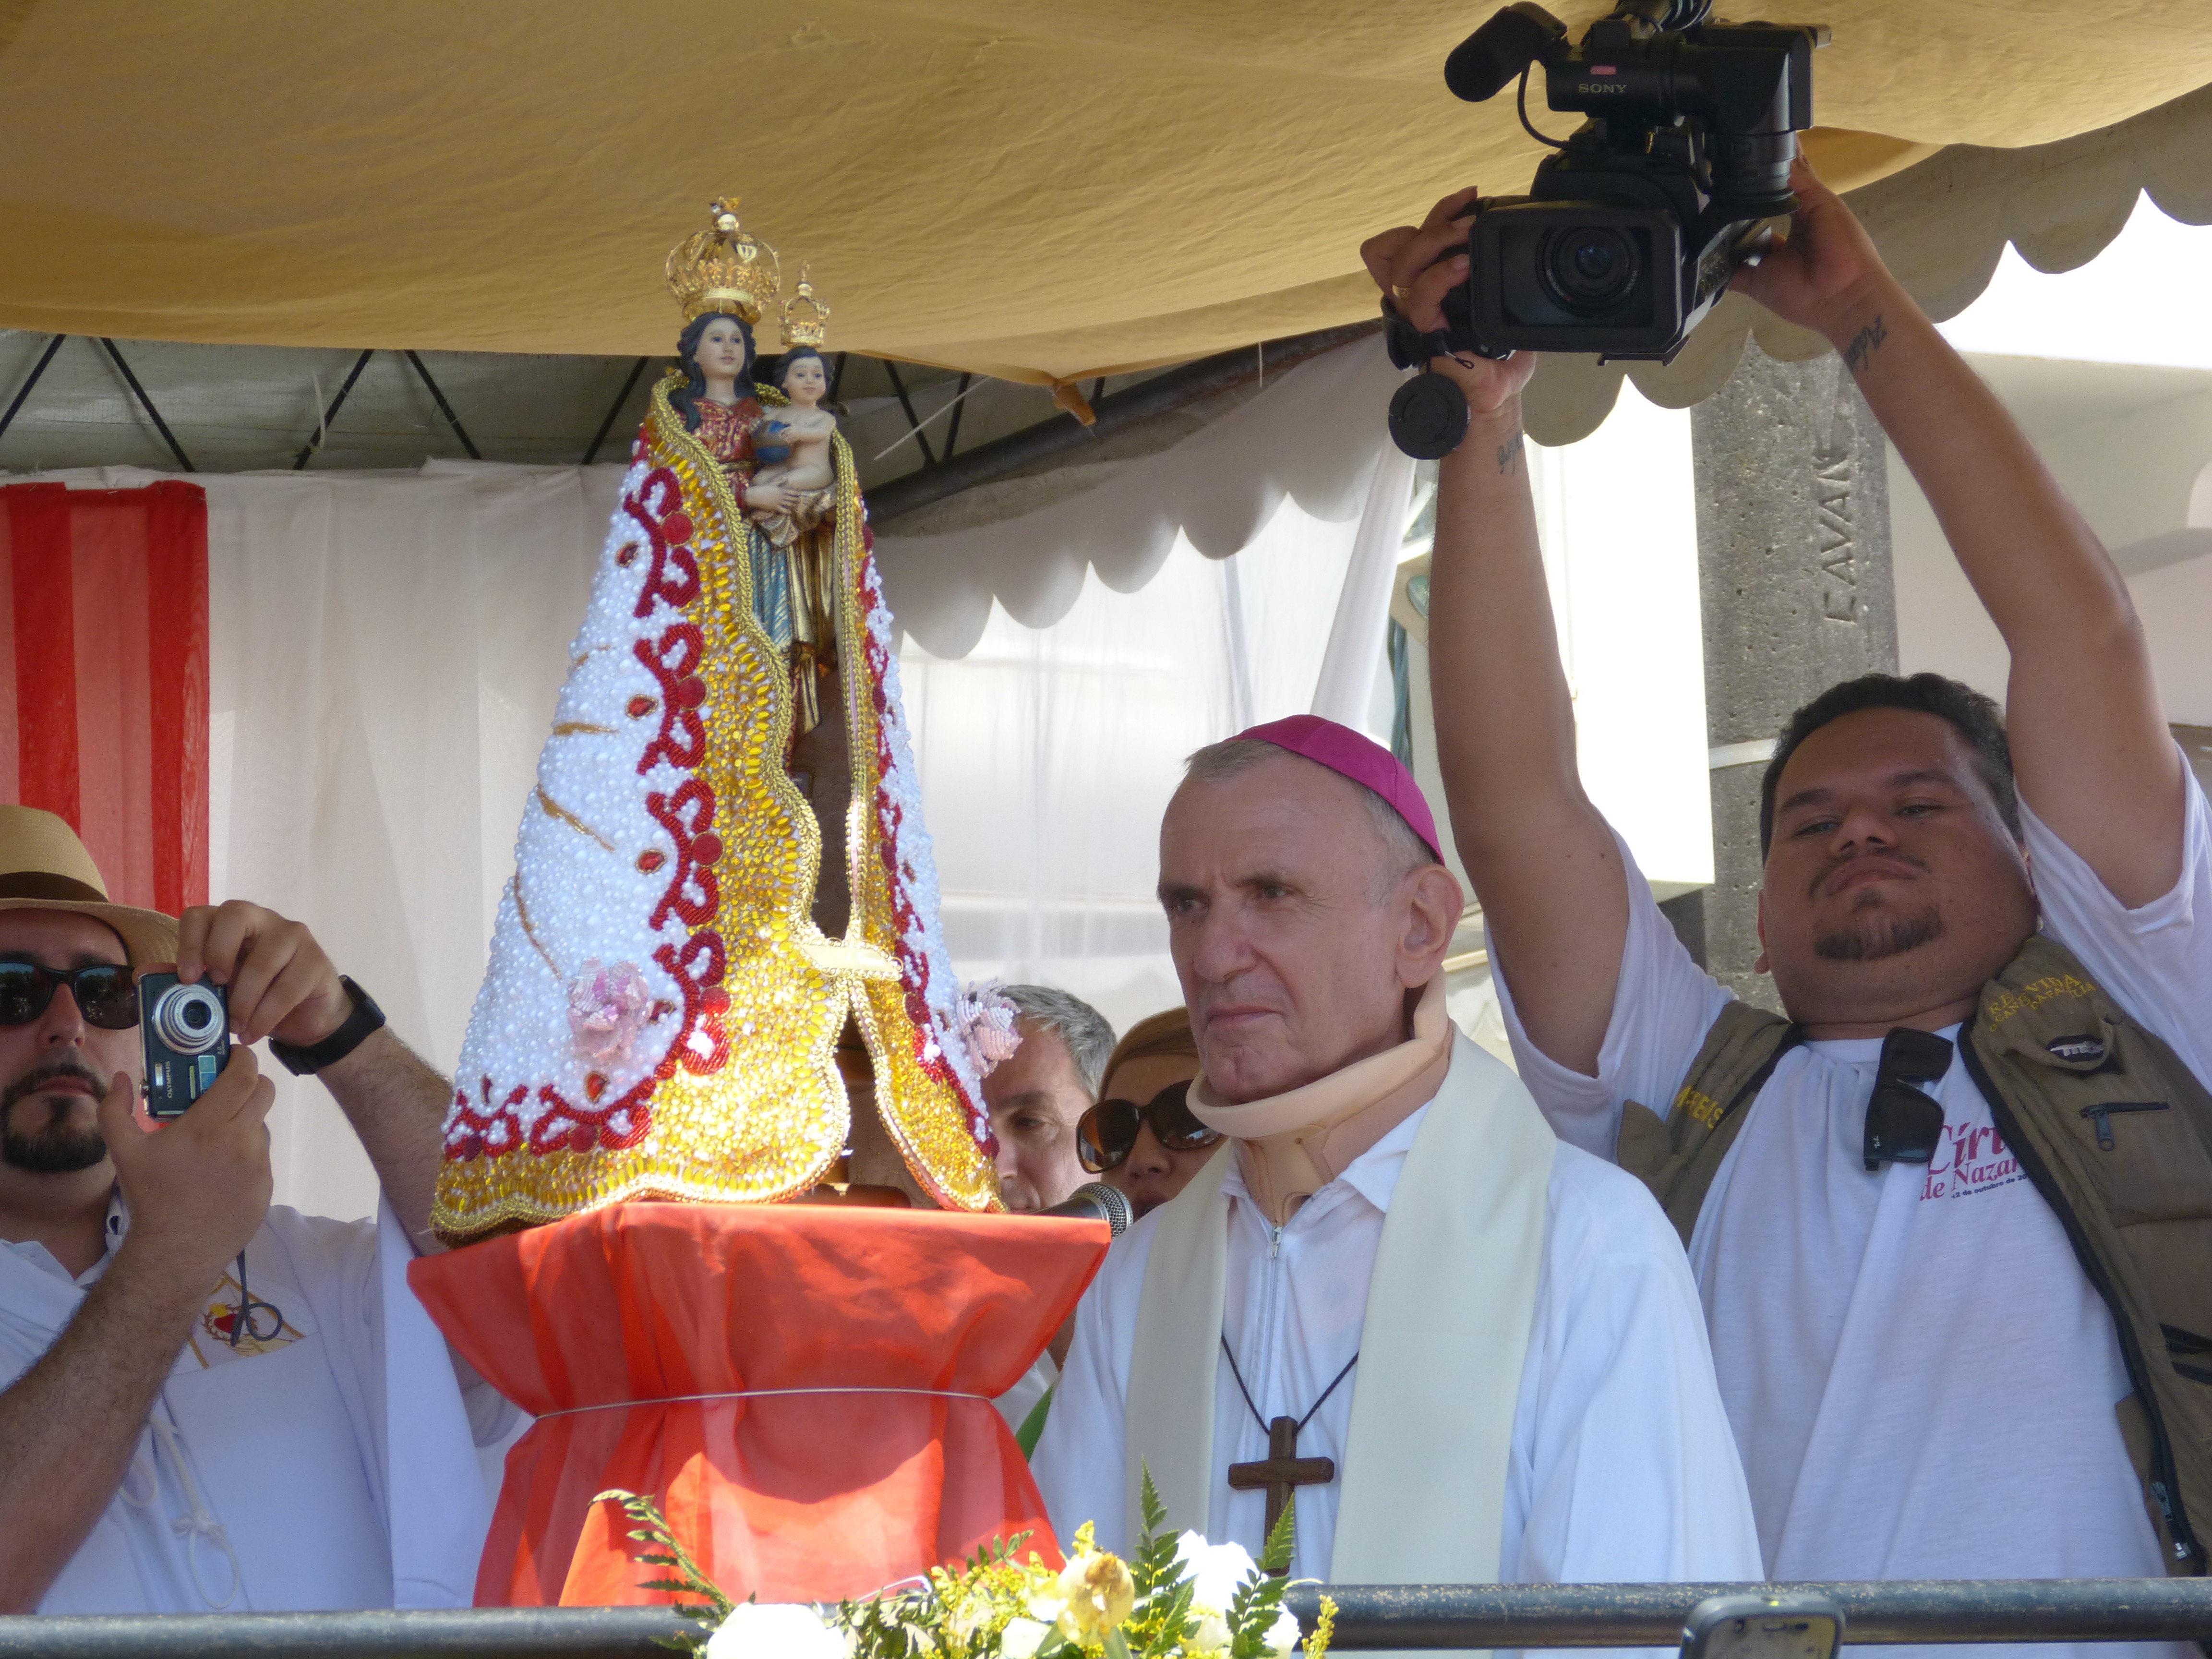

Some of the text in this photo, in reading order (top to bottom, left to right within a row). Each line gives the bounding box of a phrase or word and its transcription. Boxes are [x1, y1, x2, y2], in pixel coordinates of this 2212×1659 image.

[1578, 83, 1628, 93] SONY
[2026, 974, 2081, 992] VIDA
[165, 1061, 173, 1099] OLYMPUS
[1920, 1157, 2019, 1201] de Nazar
[1974, 1181, 2004, 1194] outubro
